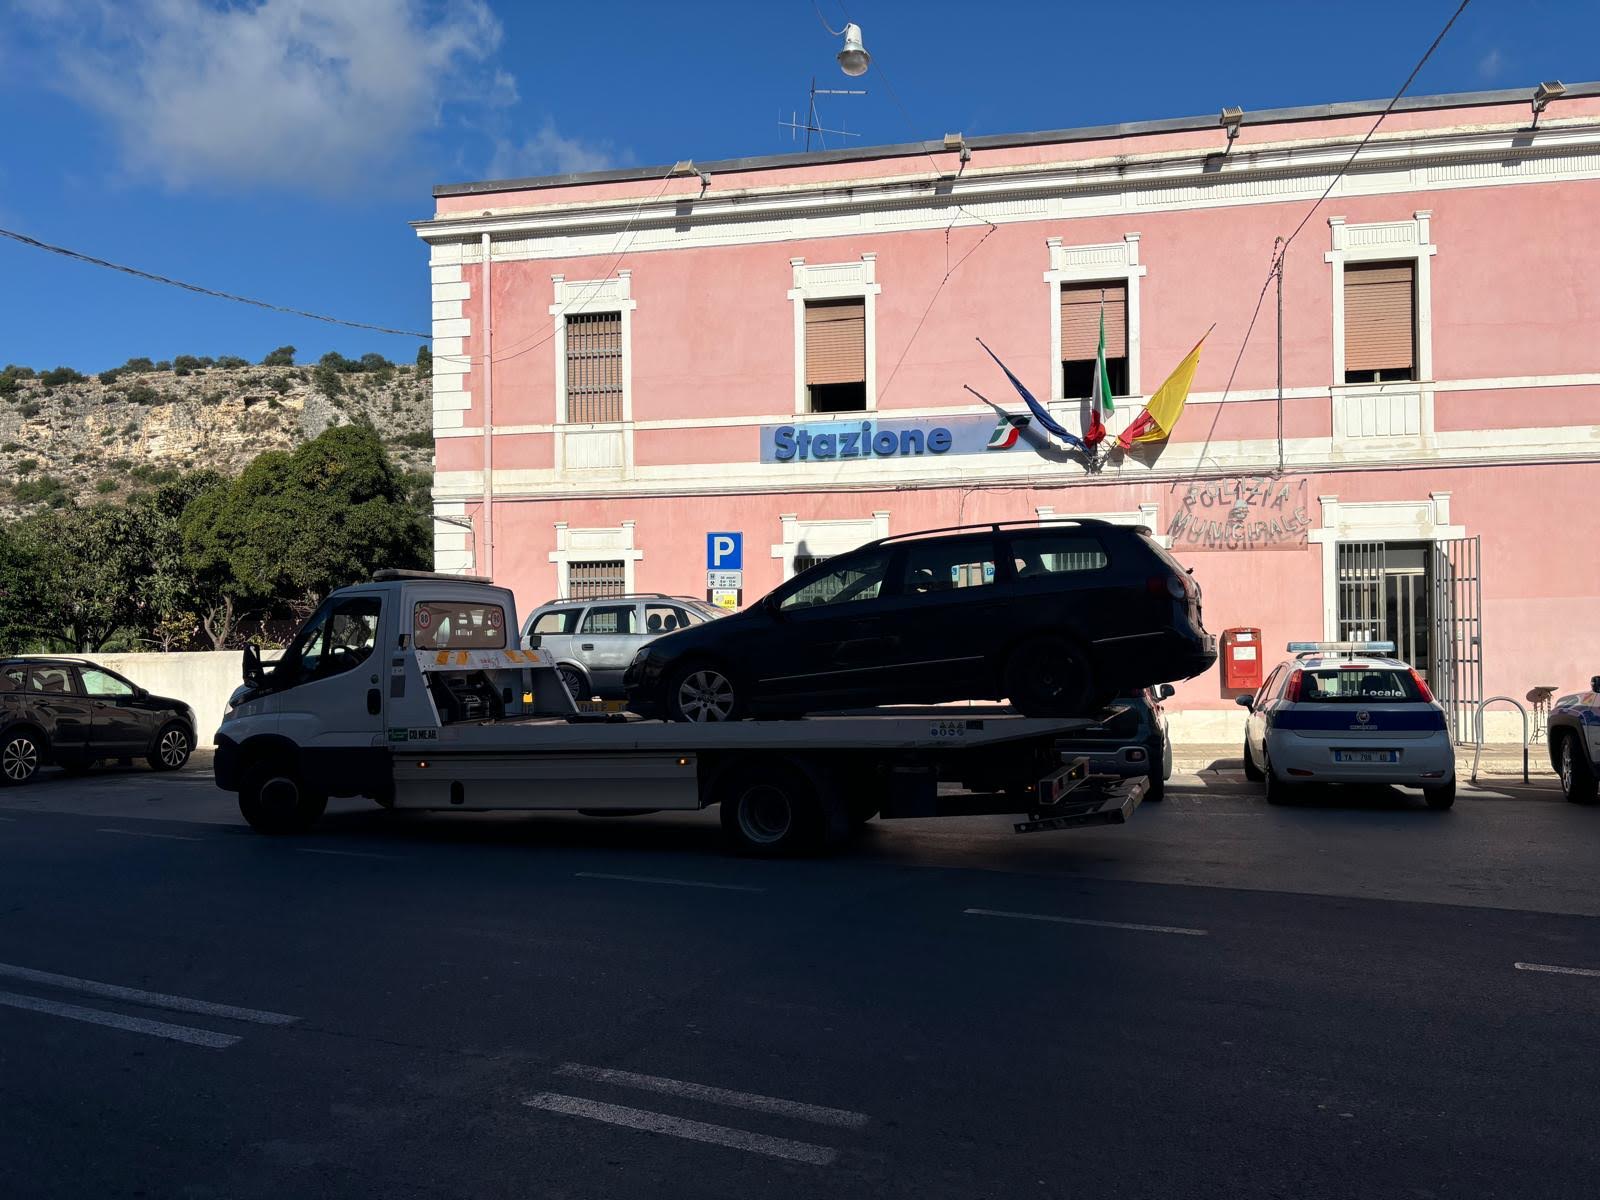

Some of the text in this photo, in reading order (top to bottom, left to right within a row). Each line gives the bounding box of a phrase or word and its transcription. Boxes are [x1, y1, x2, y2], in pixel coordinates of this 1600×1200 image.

[775, 420, 952, 460] Stazione
[1186, 476, 1290, 502] POLIZIA
[1167, 506, 1312, 546] MUNICIPALE
[714, 536, 734, 566] P
[420, 613, 429, 624] 80
[1362, 689, 1402, 697] Locale
